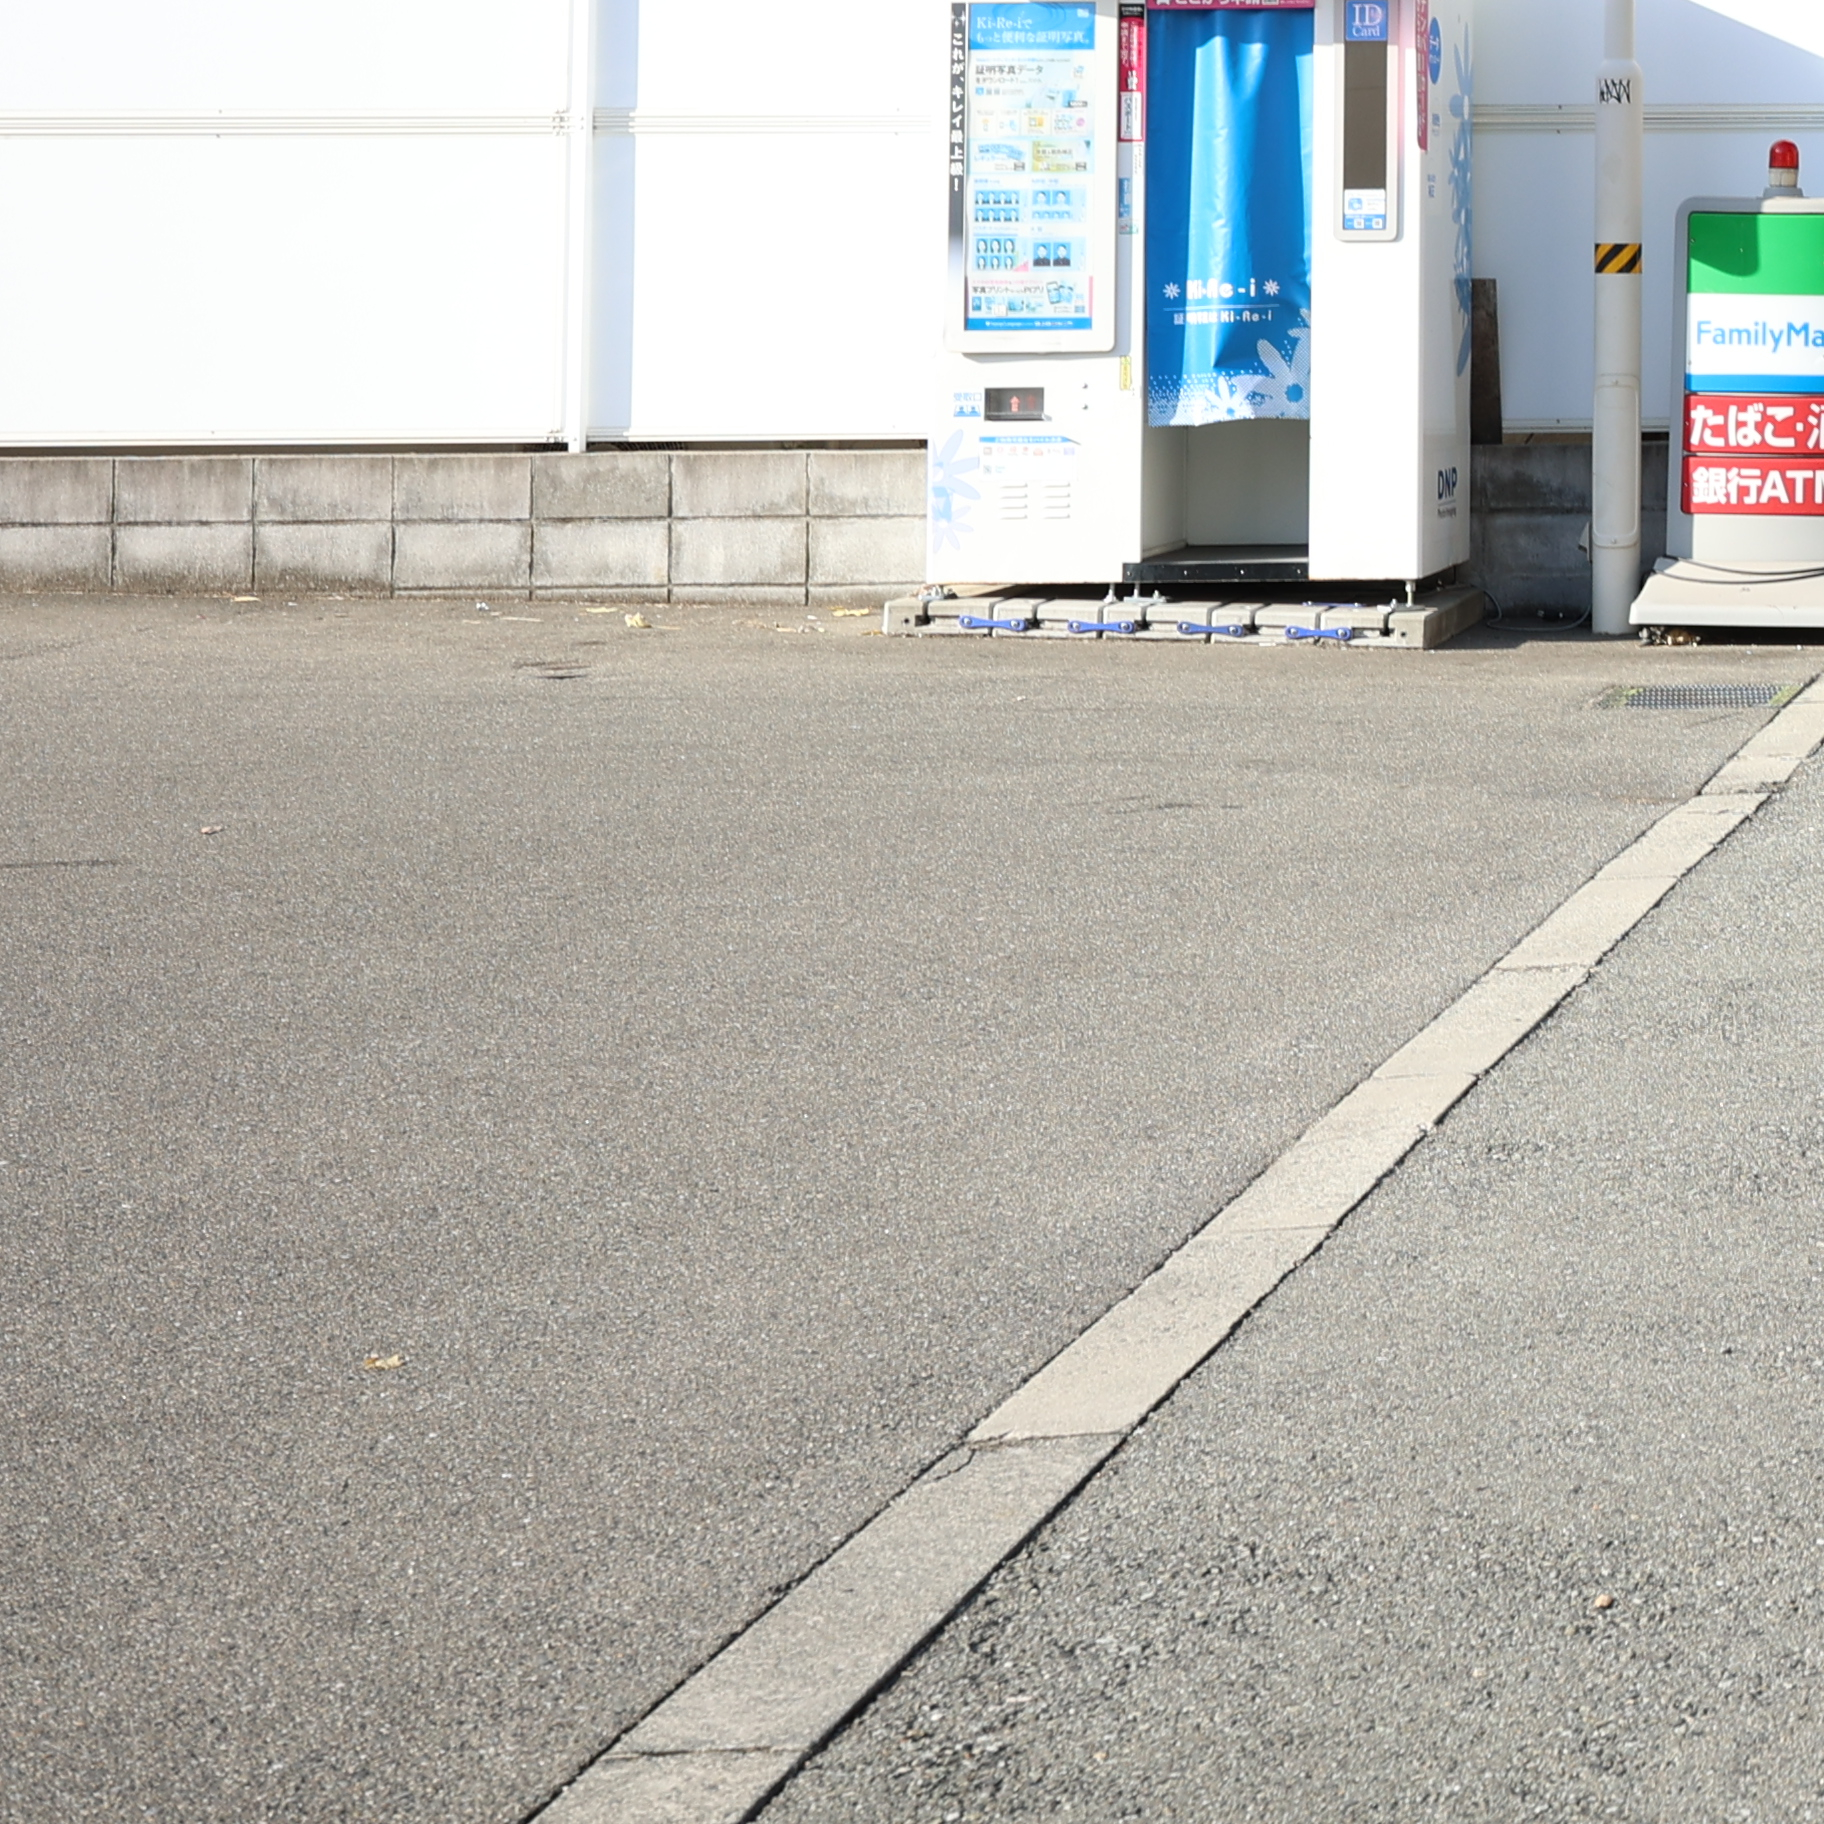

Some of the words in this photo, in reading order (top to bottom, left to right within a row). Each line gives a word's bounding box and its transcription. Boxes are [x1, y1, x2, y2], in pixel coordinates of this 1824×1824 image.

[1352, 3, 1382, 26] ID
[1352, 26, 1380, 37] Card
[1438, 466, 1458, 500] DNP
